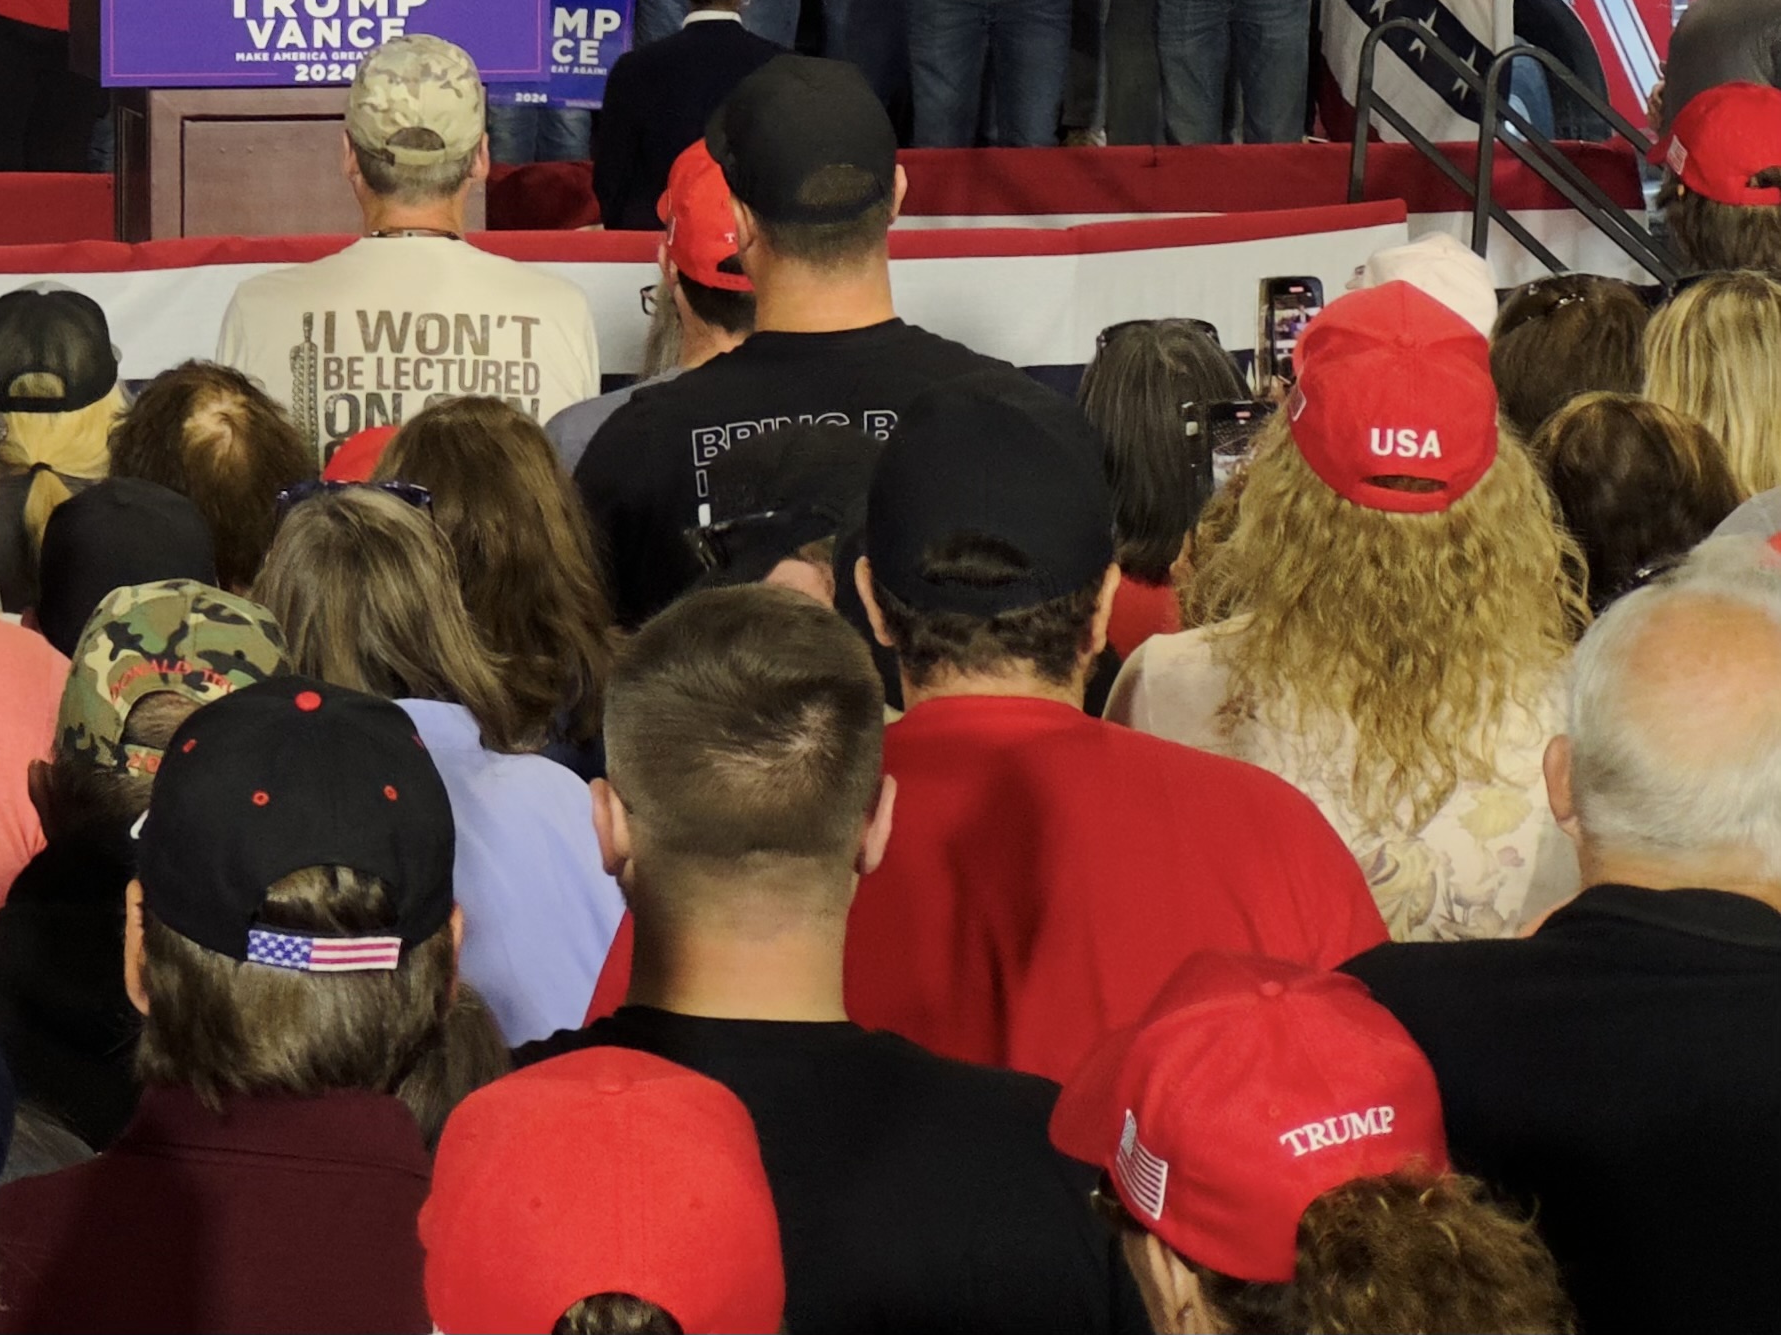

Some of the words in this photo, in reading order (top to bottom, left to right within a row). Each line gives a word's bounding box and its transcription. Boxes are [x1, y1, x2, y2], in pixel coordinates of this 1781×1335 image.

[245, 18, 406, 49] VANCE
[235, 52, 269, 62] MAKE
[273, 51, 328, 62] AMERICA
[331, 50, 368, 61] GREA
[294, 64, 356, 82] 2024
[515, 92, 548, 103] 2024
[323, 311, 336, 354] I
[356, 310, 541, 359] WON'T
[323, 356, 364, 391] BE
[376, 357, 541, 395] LECTURED
[324, 392, 402, 439] ON
[1370, 427, 1442, 459] USA
[109, 659, 193, 703] DONALD
[1279, 1105, 1396, 1158] TRUMP
